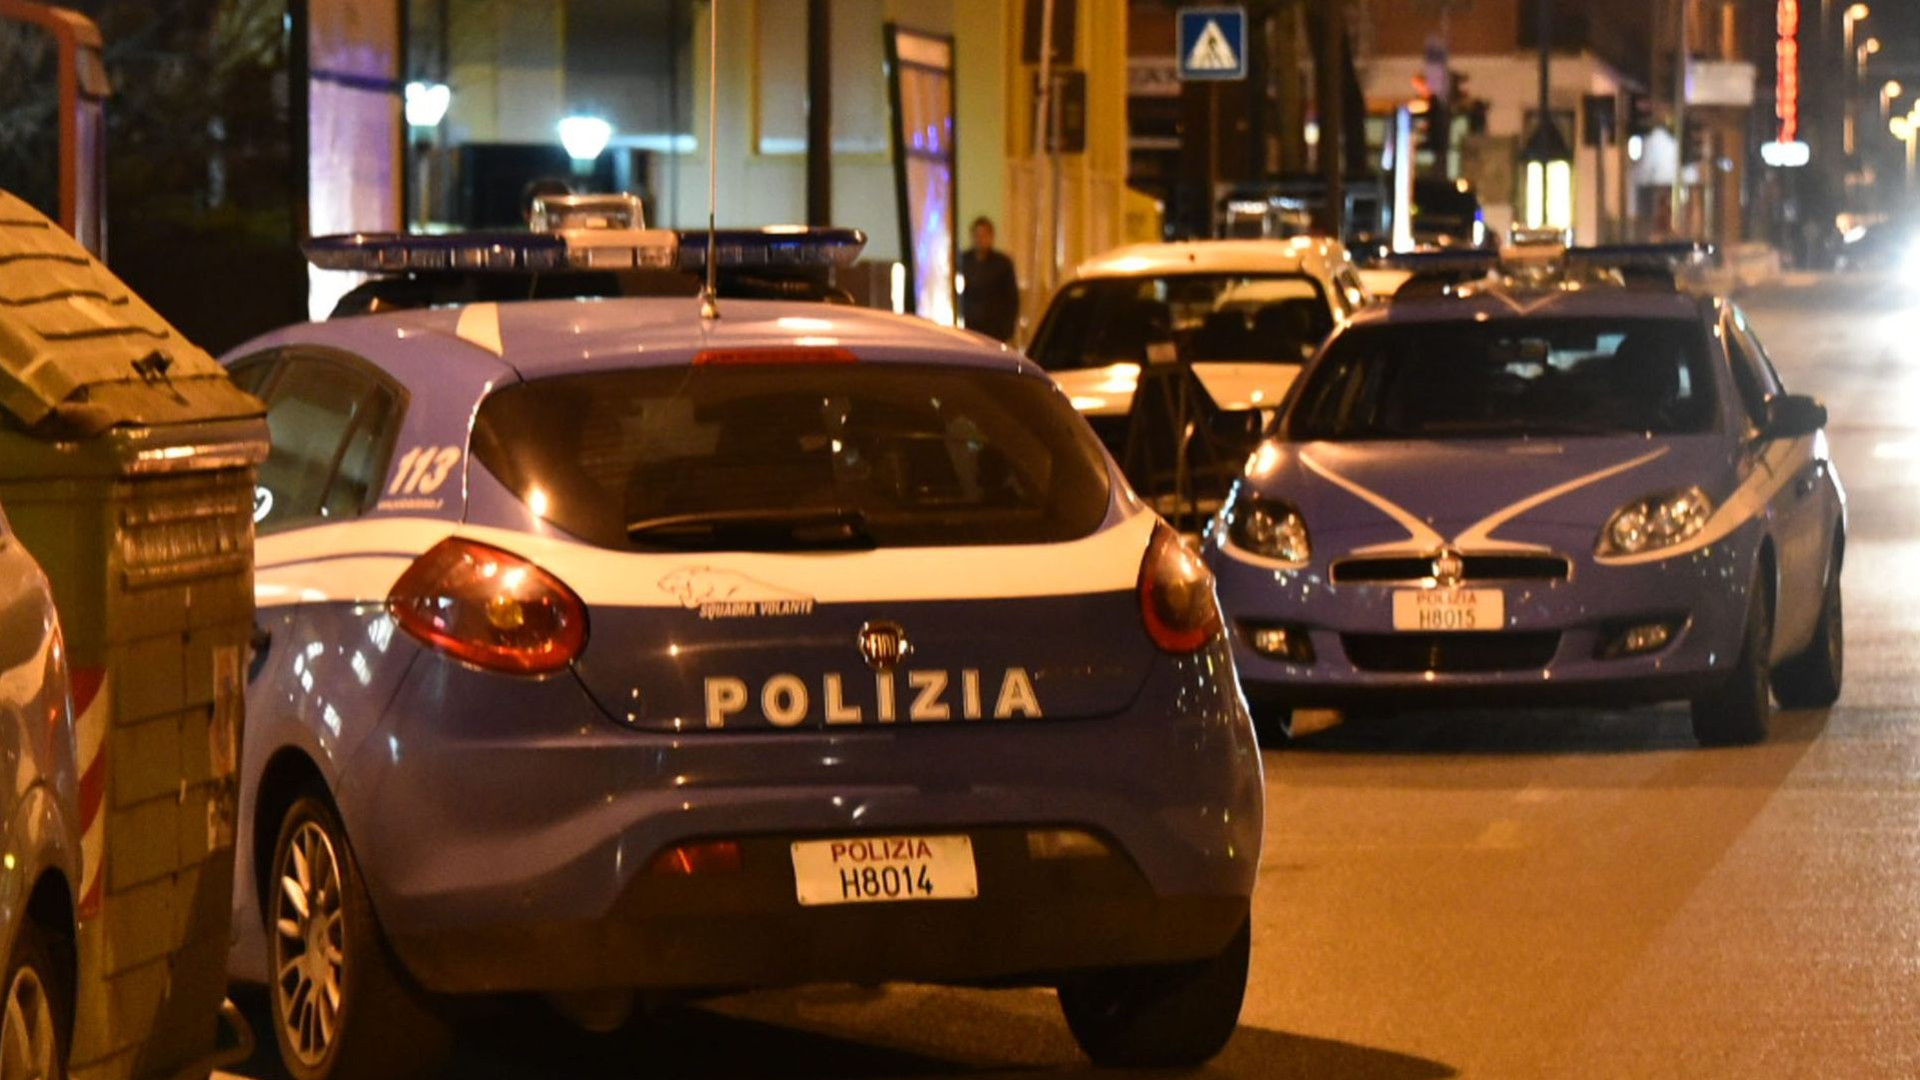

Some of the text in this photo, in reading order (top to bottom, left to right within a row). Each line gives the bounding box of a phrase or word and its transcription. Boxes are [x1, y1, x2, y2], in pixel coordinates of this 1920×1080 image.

[388, 446, 461, 495] 113
[699, 599, 814, 620] SQUADRA VOLANTE
[1419, 608, 1476, 629] H8015
[704, 667, 1043, 728] POLIZIA
[830, 839, 932, 863] POLIZIA
[840, 865, 933, 899] H8014
